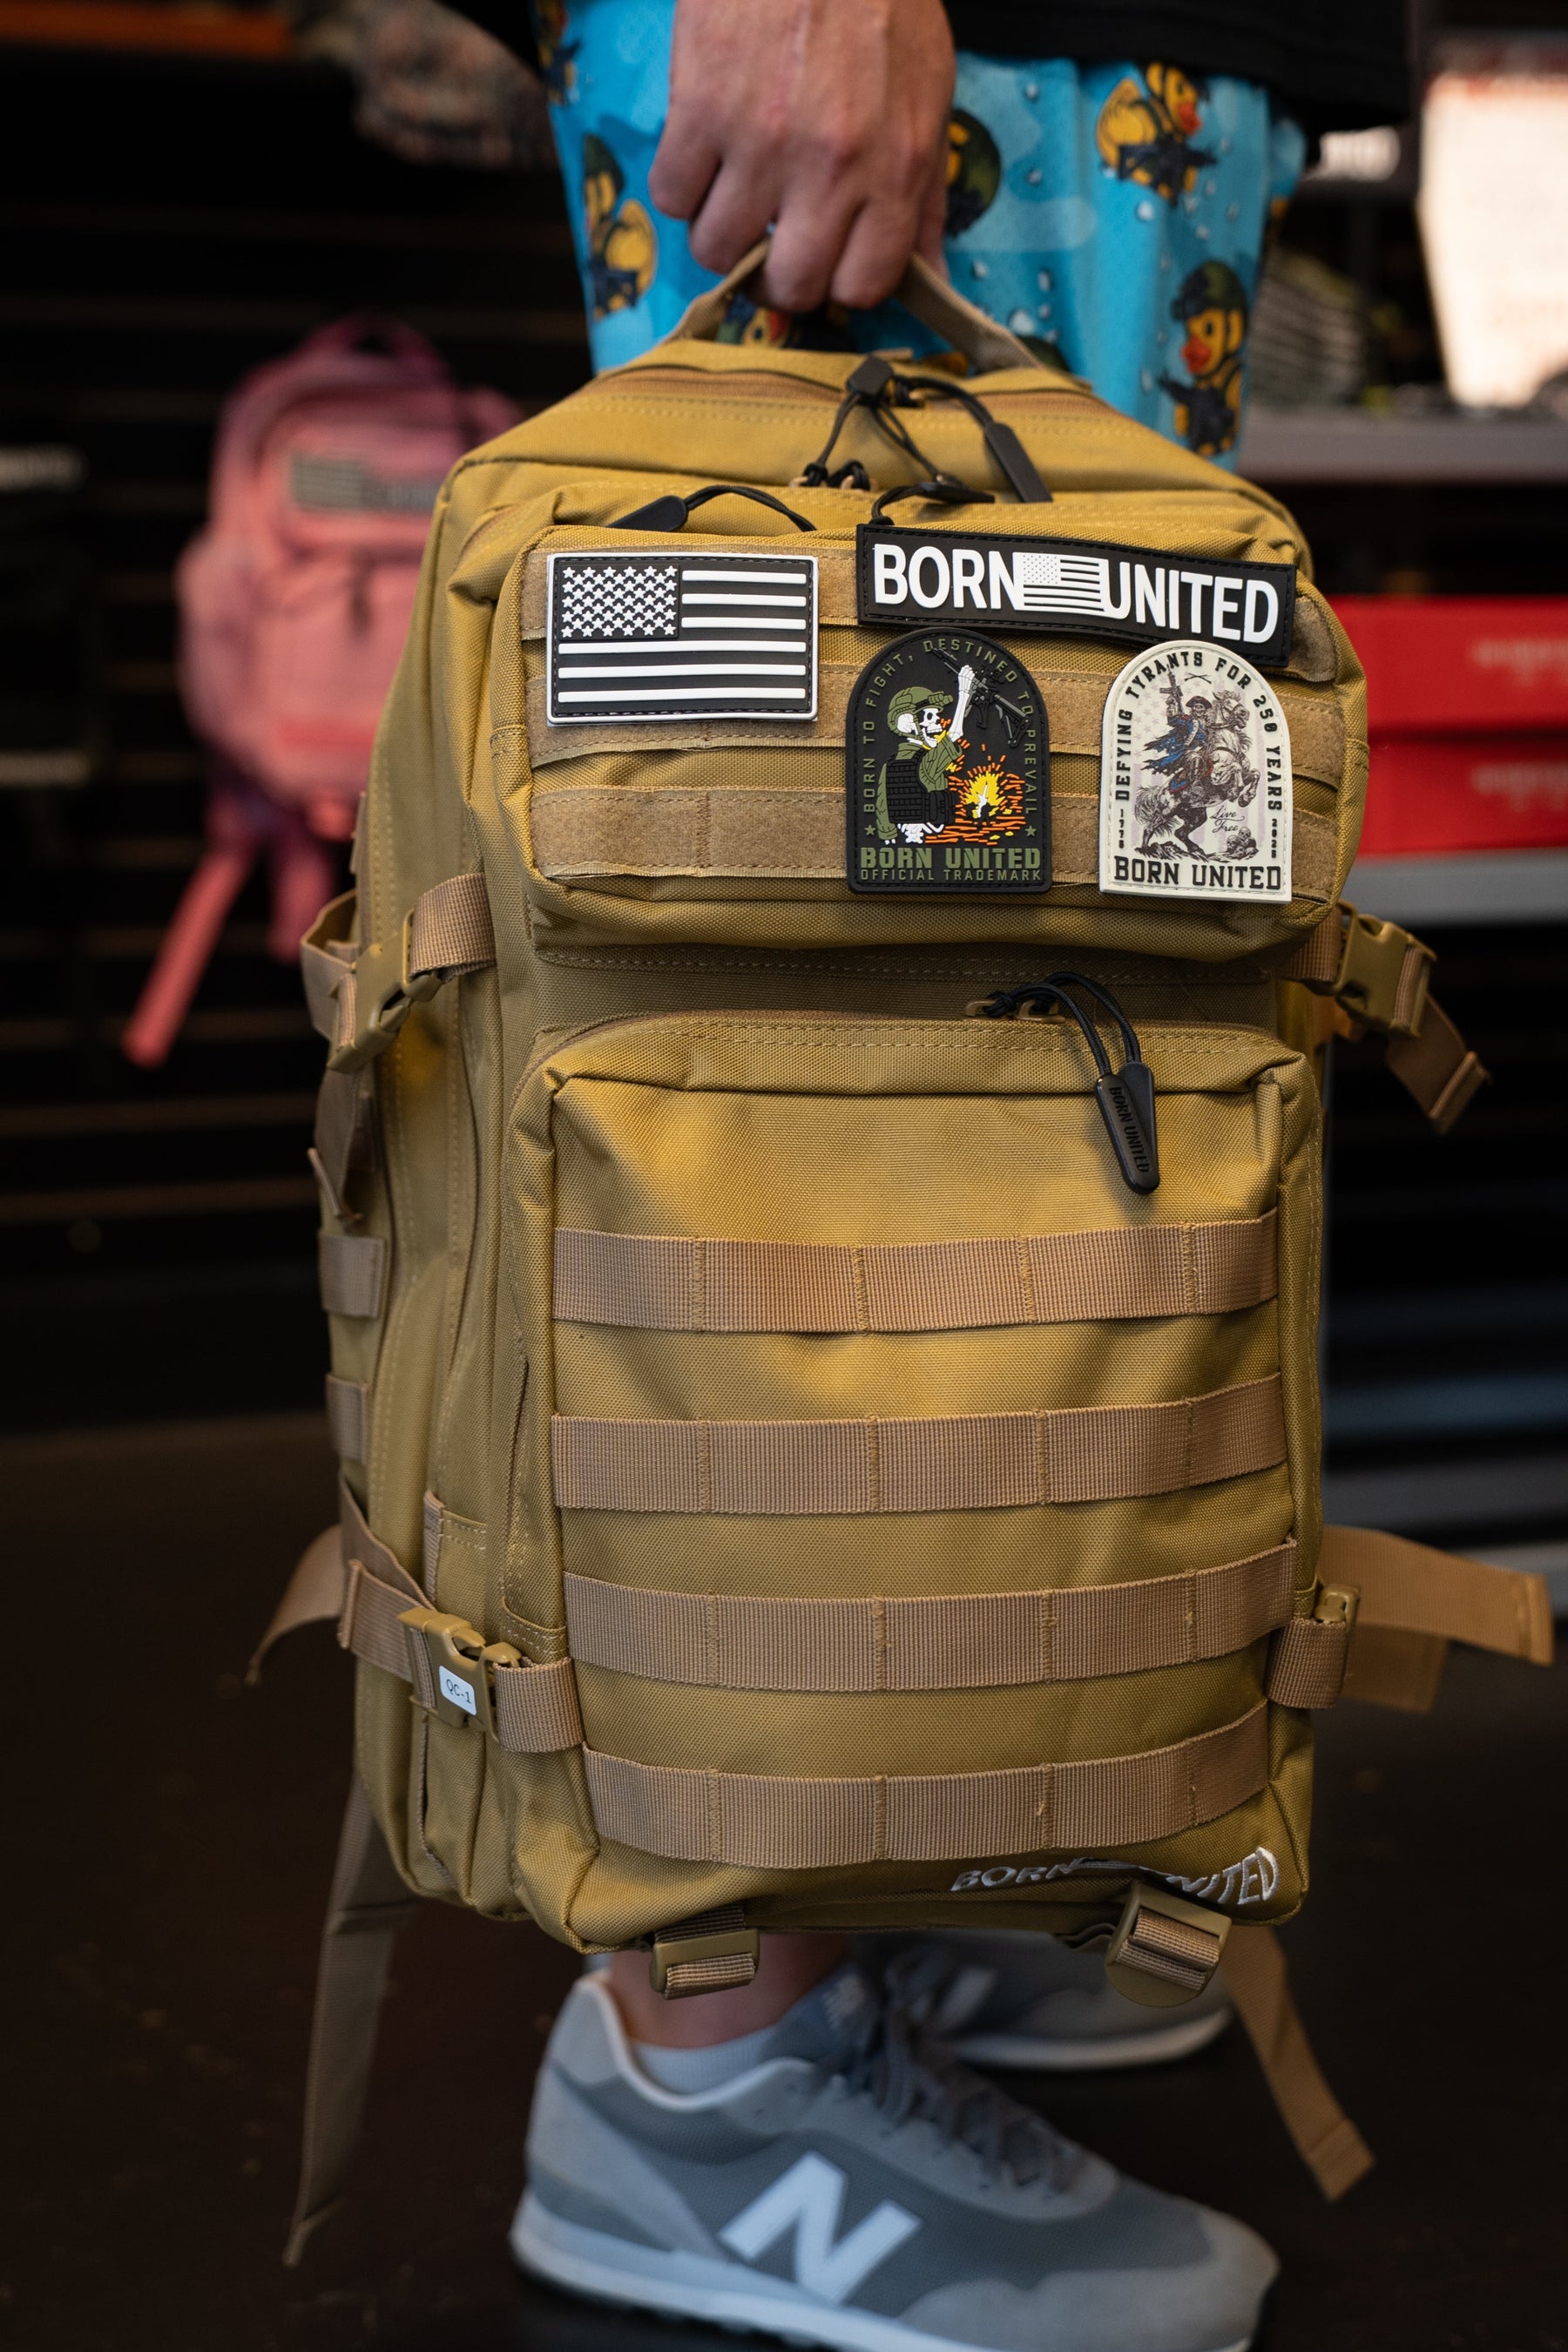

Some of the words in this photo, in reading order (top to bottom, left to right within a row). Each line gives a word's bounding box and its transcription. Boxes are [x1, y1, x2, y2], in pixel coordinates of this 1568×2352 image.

[874, 543, 1024, 611] BORN
[1099, 558, 1279, 643] UNITED
[923, 638, 1017, 685] DESTINED
[1017, 691, 1035, 717] TO
[863, 720, 875, 745] TO
[1116, 708, 1133, 801] DEFYING
[1125, 651, 1203, 699] TYRANTS
[1214, 657, 1252, 690] FOR
[1253, 694, 1278, 733] 250
[1266, 745, 1282, 811] YEARS
[863, 758, 875, 814] BORN
[1024, 728, 1037, 814] PREVAIL
[861, 847, 933, 868] BORN
[945, 848, 1041, 869] UNITED
[861, 868, 934, 881] OFFICIAL
[943, 869, 1041, 882] TRADEMARK
[1114, 855, 1179, 885] BORN
[1192, 864, 1281, 890] UNITED
[1109, 1086, 1132, 1122] BORN
[1124, 1125, 1152, 1173] UNITED
[446, 1679, 471, 1704] QC-1
